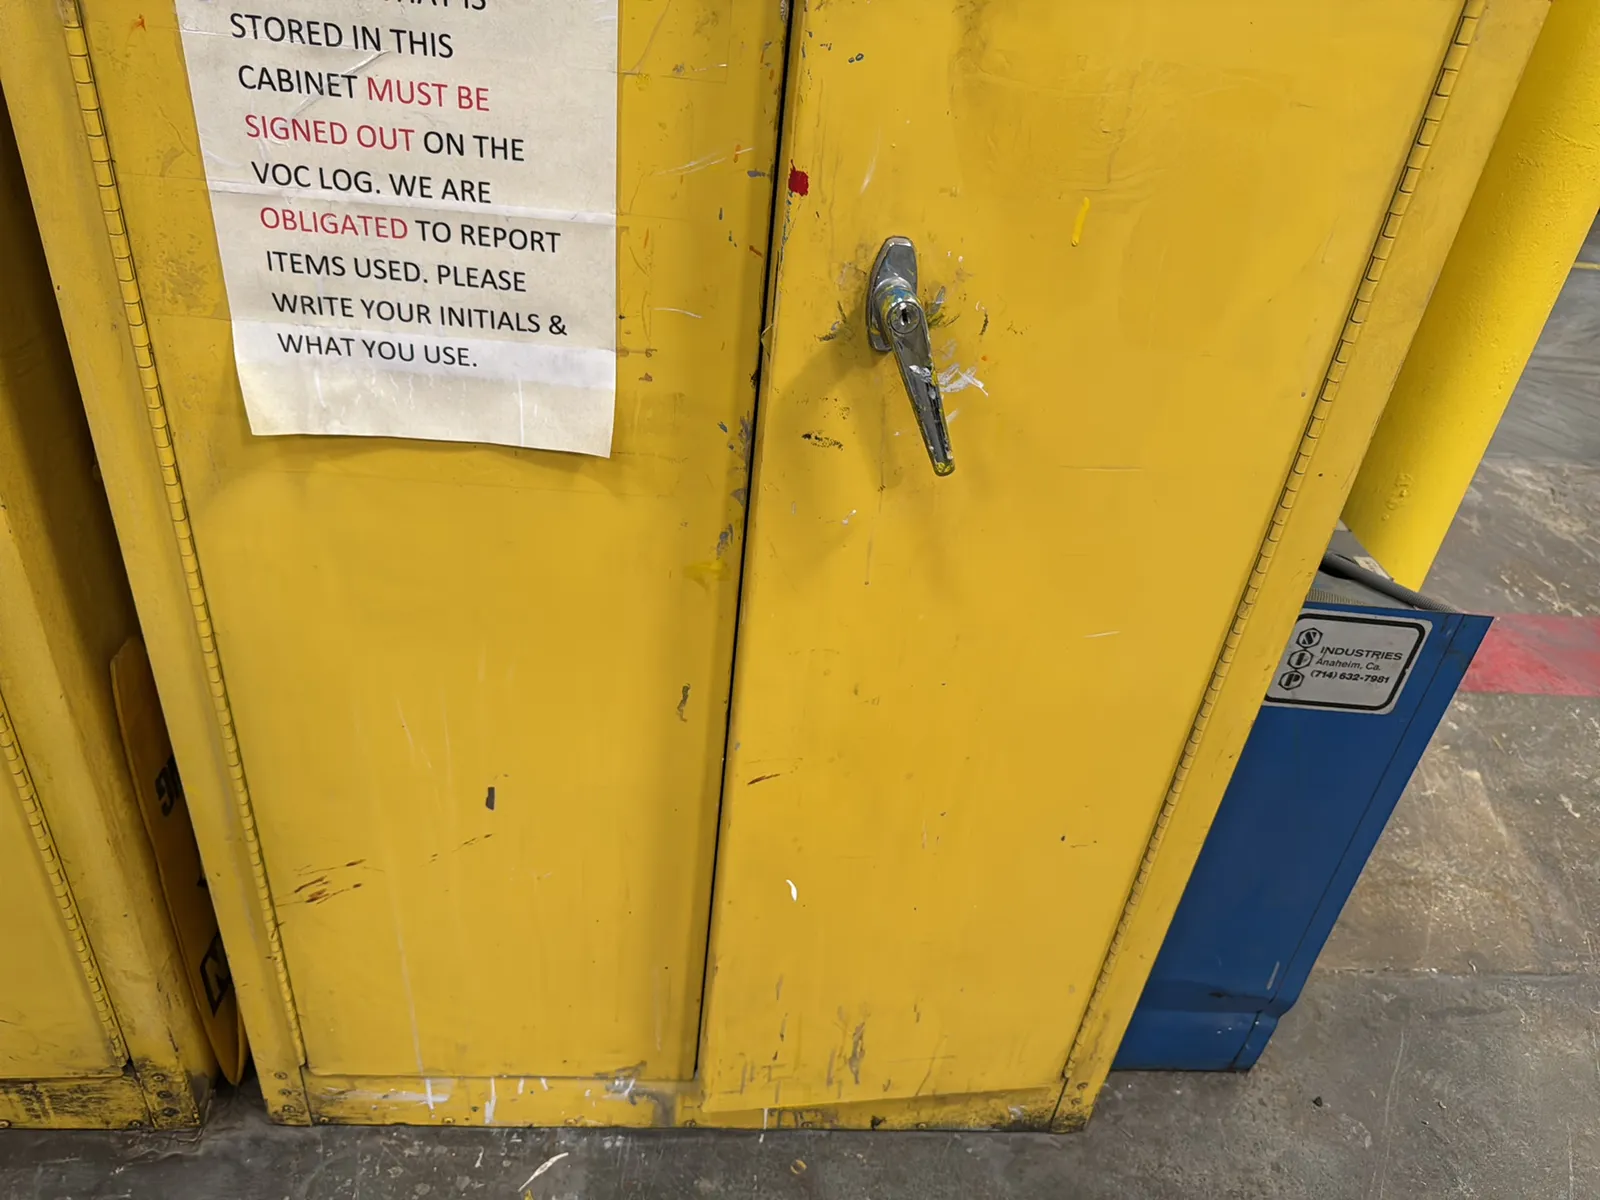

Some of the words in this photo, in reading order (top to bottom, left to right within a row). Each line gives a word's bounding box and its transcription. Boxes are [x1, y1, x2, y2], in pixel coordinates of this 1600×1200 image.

[231, 13, 342, 47] STORED
[353, 25, 381, 51] IN
[390, 29, 453, 58] THIS
[239, 65, 357, 98] CABINET
[368, 77, 447, 106] MUST
[458, 86, 489, 111] BE
[246, 115, 347, 144] SIGNED
[357, 125, 414, 151] OUT
[424, 131, 464, 156] ON
[473, 135, 524, 161] THE
[251, 162, 310, 187] VOC
[319, 168, 380, 193] LOG.
[389, 174, 432, 198] WE
[442, 179, 491, 203] ARE
[261, 208, 407, 238] OBLIGATED
[415, 220, 451, 242] TO
[461, 224, 560, 252] REPORT
[267, 251, 345, 276] ITEMS
[354, 258, 427, 283] USED.
[438, 265, 526, 292] PLEASE
[272, 293, 353, 317] WRITE
[361, 299, 431, 324] YOUR
[441, 306, 540, 332] INITIALS
[549, 315, 567, 335] &
[278, 333, 355, 356] WHAT
[362, 340, 414, 361] YOU
[425, 345, 478, 367] USE.
[1315, 658, 1363, 670] Anaheim,
[1365, 661, 1382, 671] Ca.
[1320, 646, 1403, 660] INDUSTRIES
[1310, 669, 1338, 679] (714)
